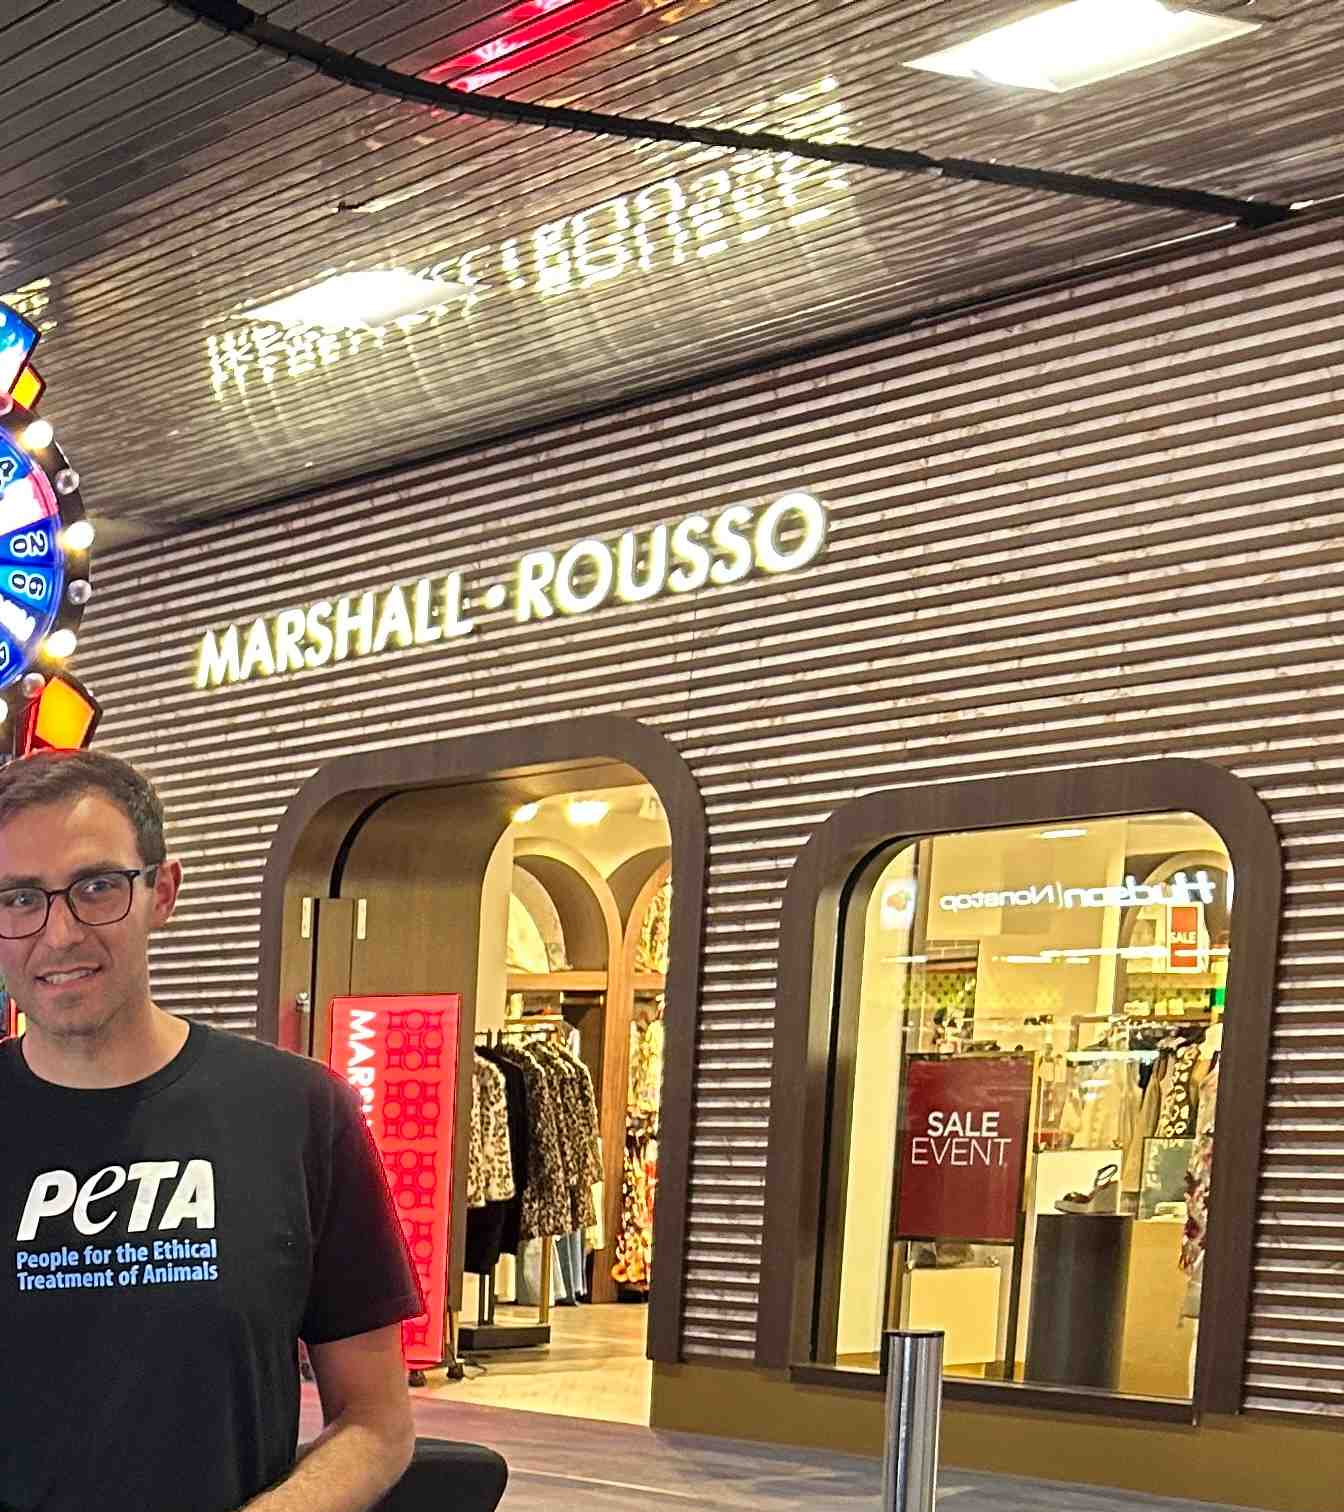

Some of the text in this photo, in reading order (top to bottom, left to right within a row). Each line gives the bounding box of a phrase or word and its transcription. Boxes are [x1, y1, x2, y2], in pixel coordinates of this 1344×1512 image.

[11, 529, 48, 557] 20
[192, 489, 830, 689] MARSHALL ROUSSO
[1170, 932, 1197, 944] SALE
[928, 1111, 1000, 1138] SALE
[911, 1137, 1012, 1167] EVENT
[16, 1159, 216, 1242] PeTA
[16, 1238, 217, 1271] People for the Ethical
[17, 1261, 218, 1290] Treatment of Animals
